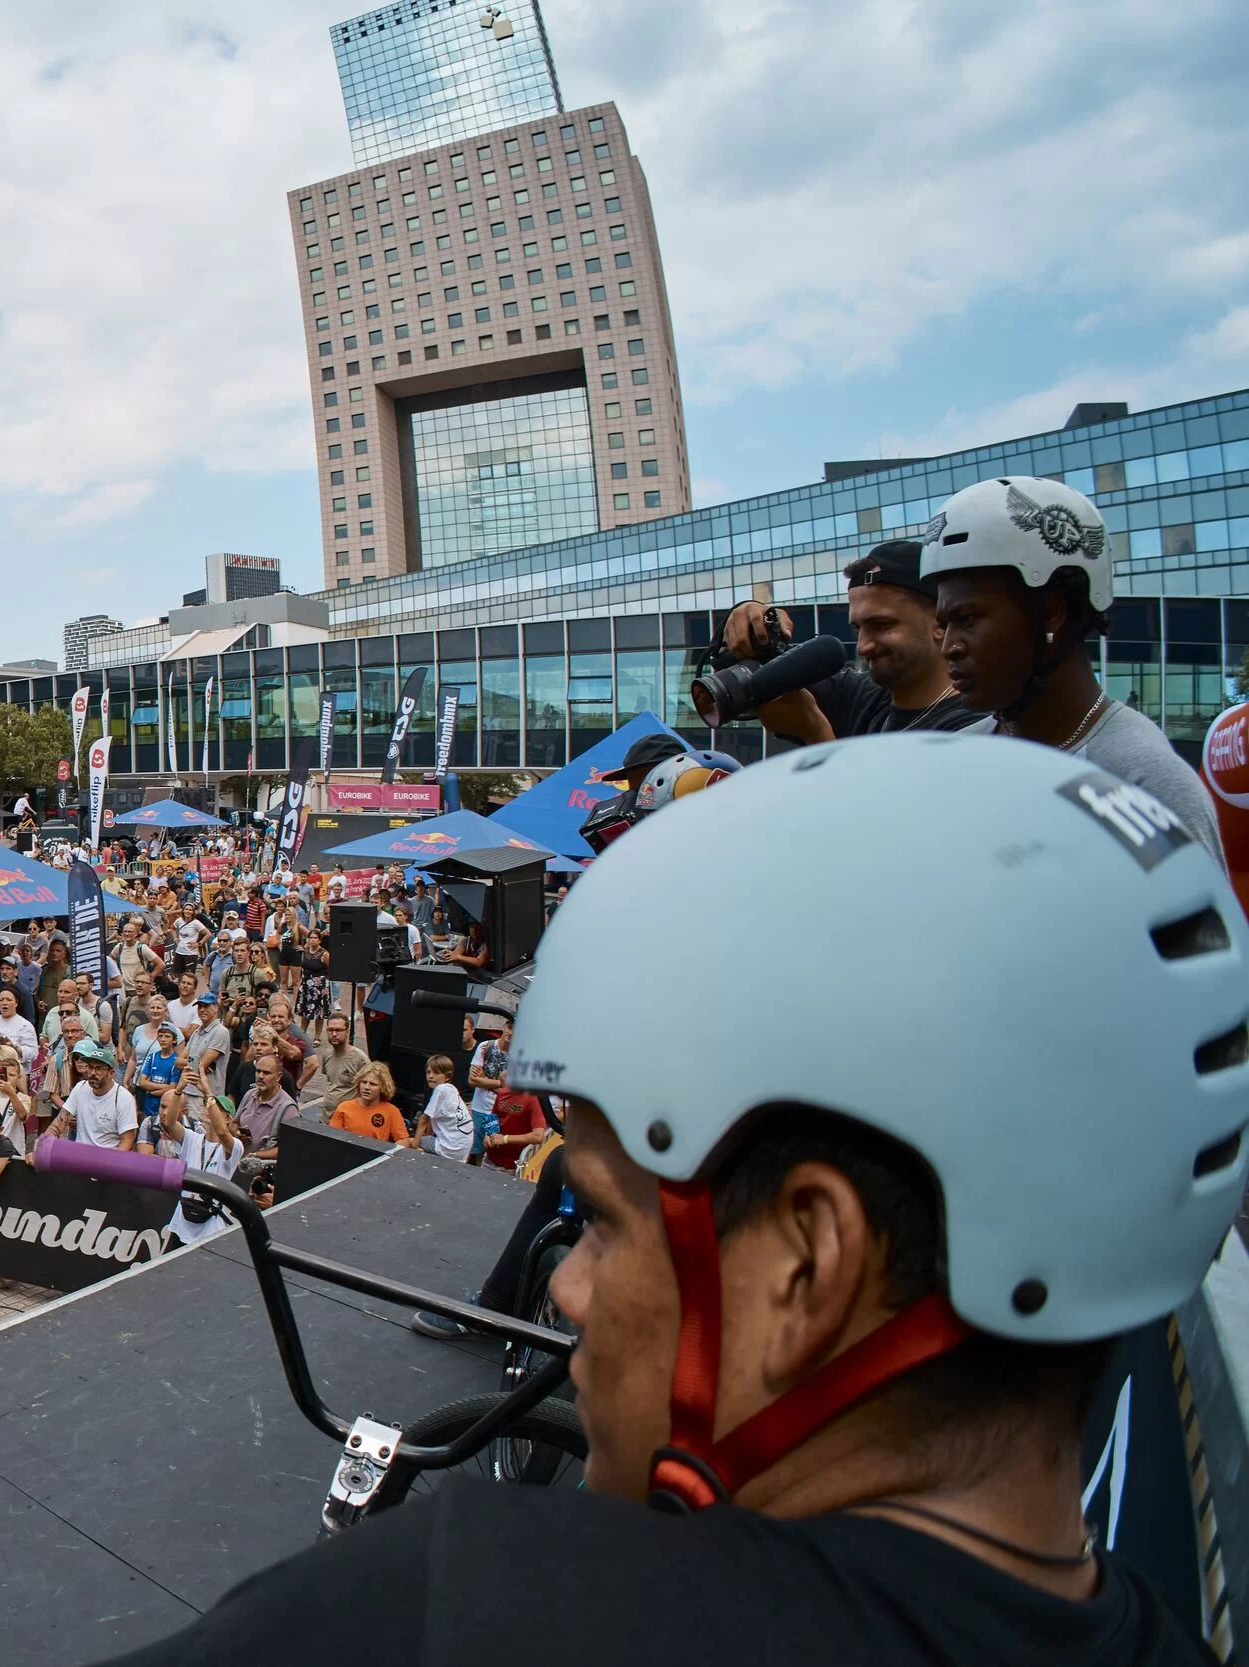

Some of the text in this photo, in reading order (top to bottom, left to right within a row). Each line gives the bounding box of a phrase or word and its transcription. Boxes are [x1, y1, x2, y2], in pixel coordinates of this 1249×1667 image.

[436, 695, 458, 777] freedombmx
[338, 791, 372, 800] EUROBIKE
[394, 792, 430, 801] EUROBIKE
[568, 790, 600, 810] Re
[13, 886, 59, 904] Bull
